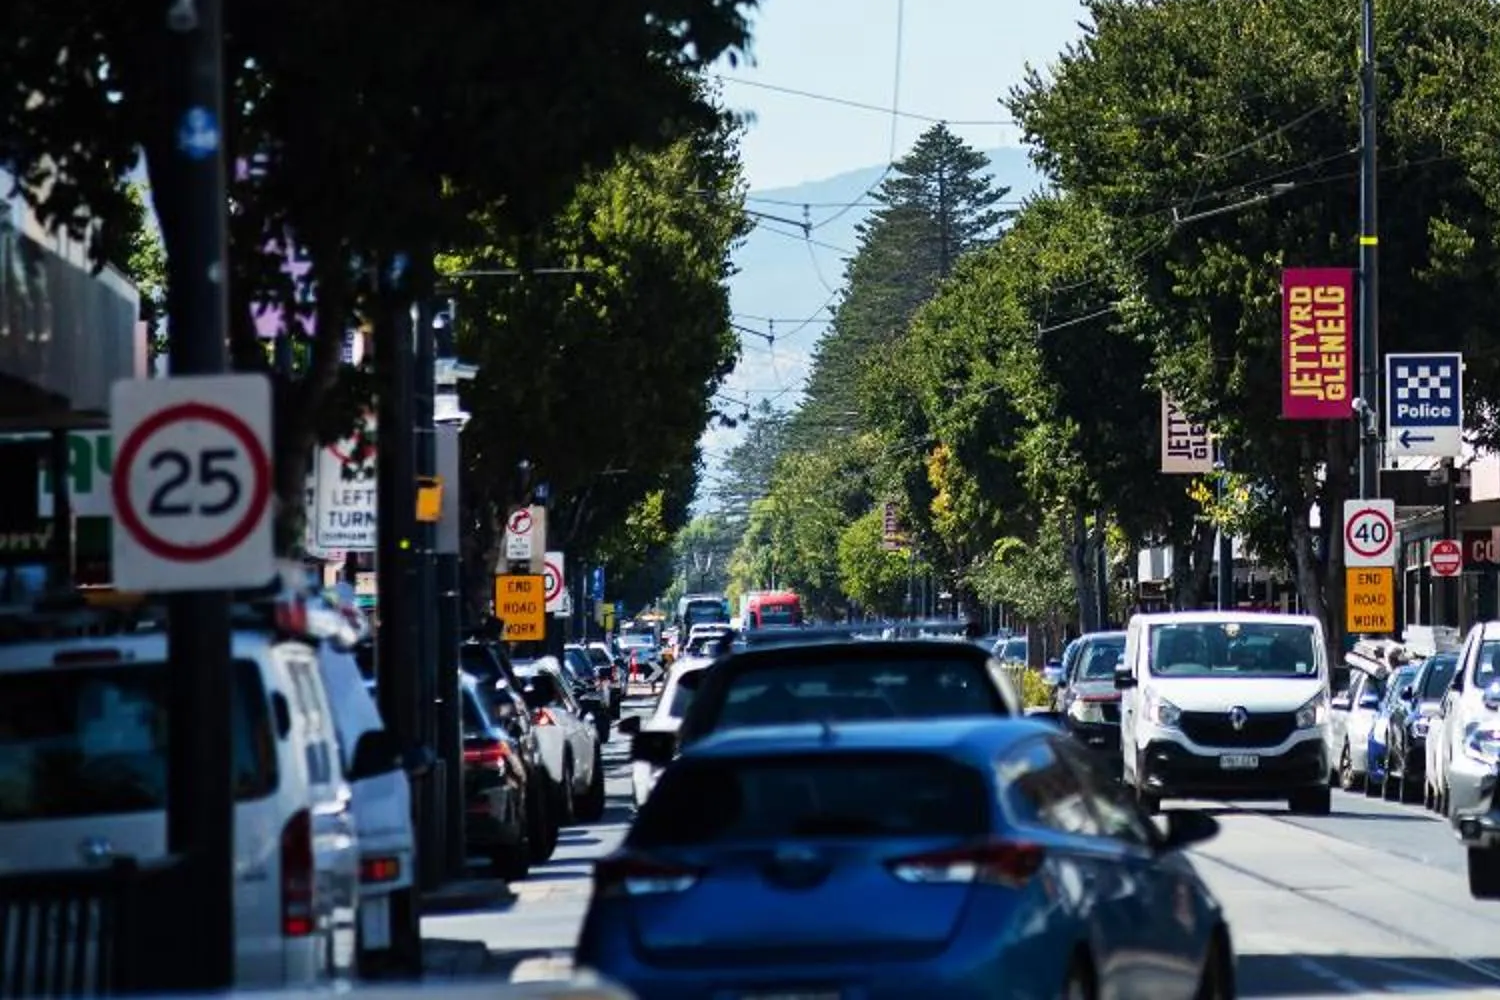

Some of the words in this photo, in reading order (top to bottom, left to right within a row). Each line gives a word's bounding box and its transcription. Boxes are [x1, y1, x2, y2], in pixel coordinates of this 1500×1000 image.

[1314, 286, 1346, 401] GLENELG
[1397, 404, 1452, 419] Police
[1168, 403, 1193, 459] JETTY
[148, 450, 242, 518] 25
[332, 489, 375, 505] LEFT
[328, 511, 375, 527] TURN
[1354, 522, 1386, 543] 40
[1357, 573, 1381, 584] END
[507, 581, 531, 593] END
[1353, 594, 1387, 606] ROAD
[504, 602, 536, 614] ROAD
[1353, 615, 1386, 627] WORK
[505, 624, 536, 635] WORK
